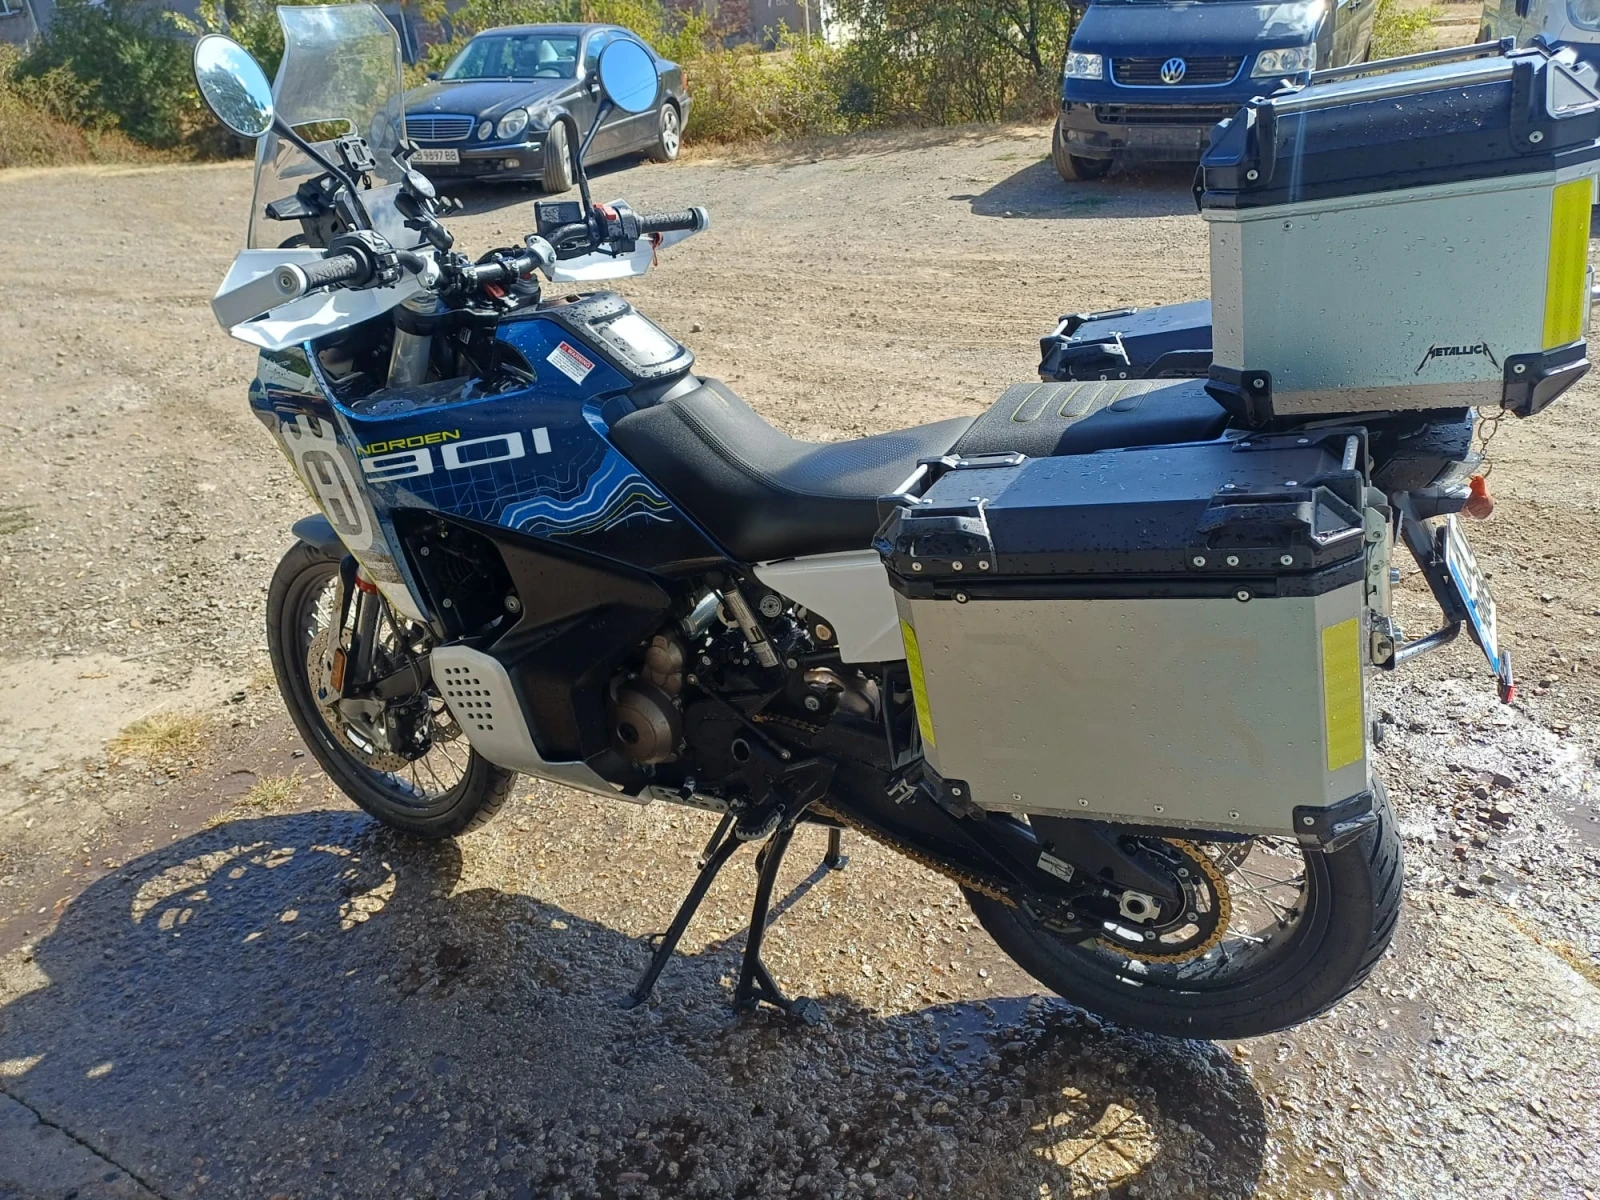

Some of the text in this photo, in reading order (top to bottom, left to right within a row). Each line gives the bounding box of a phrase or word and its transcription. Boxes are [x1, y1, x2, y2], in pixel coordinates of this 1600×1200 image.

[423, 150, 443, 161] 9897
[444, 150, 457, 161] BB
[567, 347, 592, 370] WARNING
[1413, 340, 1502, 377] METALLICA
[356, 429, 461, 456] NORDEN
[360, 426, 552, 484] 901
